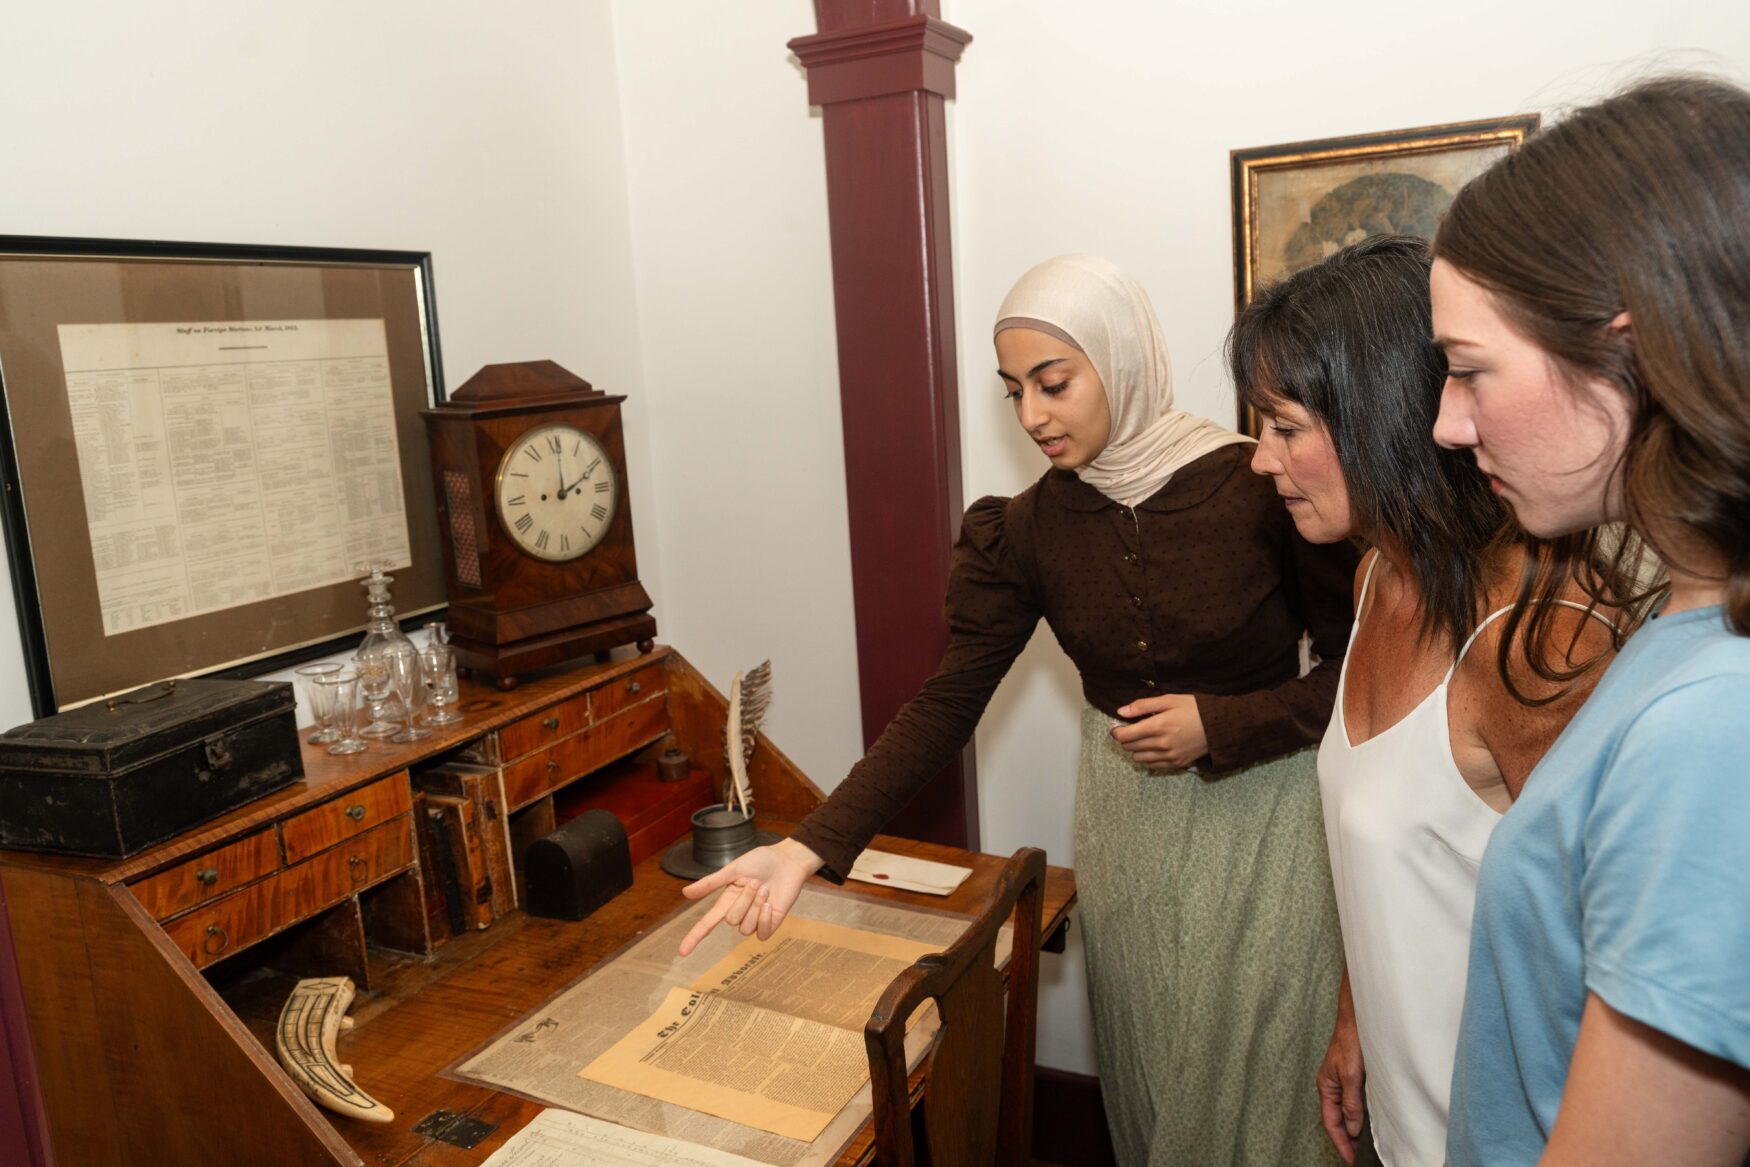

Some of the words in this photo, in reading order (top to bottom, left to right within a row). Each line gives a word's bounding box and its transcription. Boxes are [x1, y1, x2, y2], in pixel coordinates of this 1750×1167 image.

[594, 481, 609, 493] III
[590, 503, 608, 522] IIII
[657, 1021, 680, 1038] The
